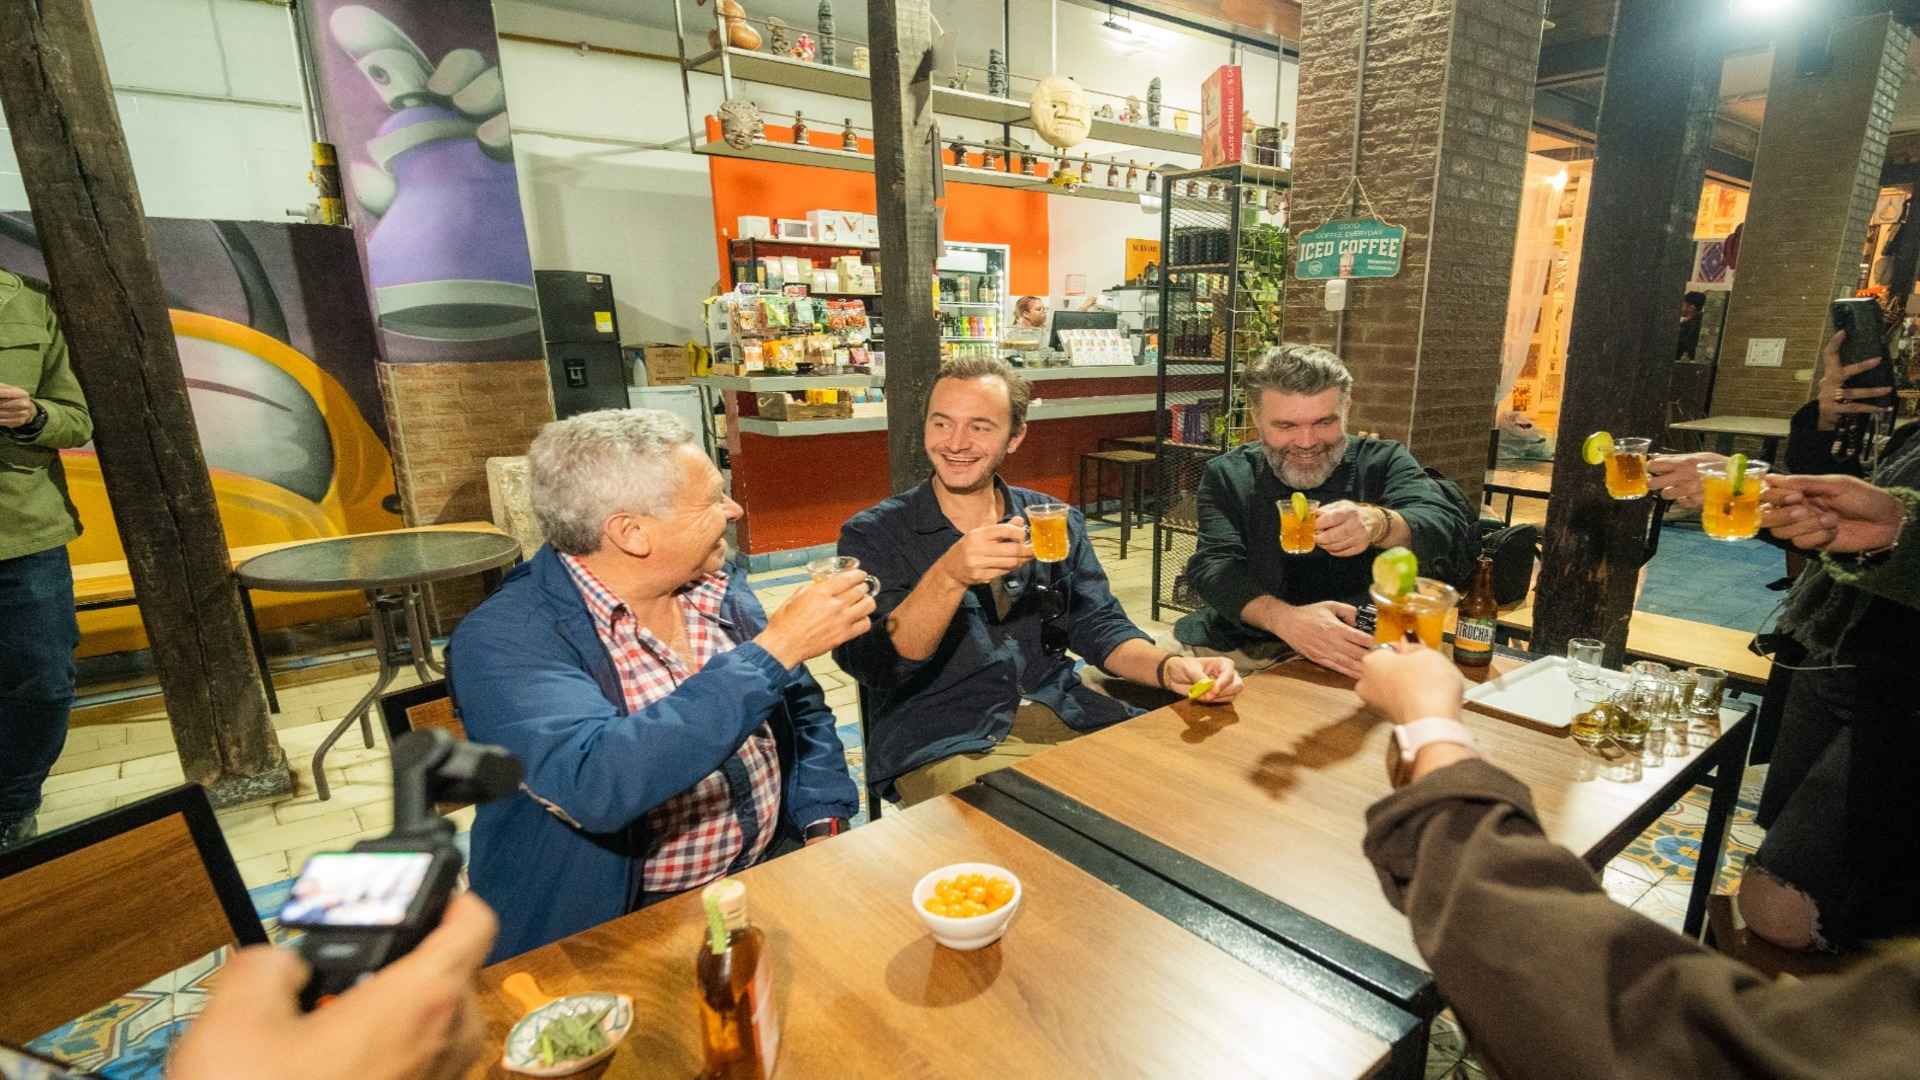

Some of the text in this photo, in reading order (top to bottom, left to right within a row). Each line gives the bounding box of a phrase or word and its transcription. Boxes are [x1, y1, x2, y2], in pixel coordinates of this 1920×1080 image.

[1316, 231, 1344, 239] COFFEE
[1299, 238, 1400, 262] ICED COFFEE
